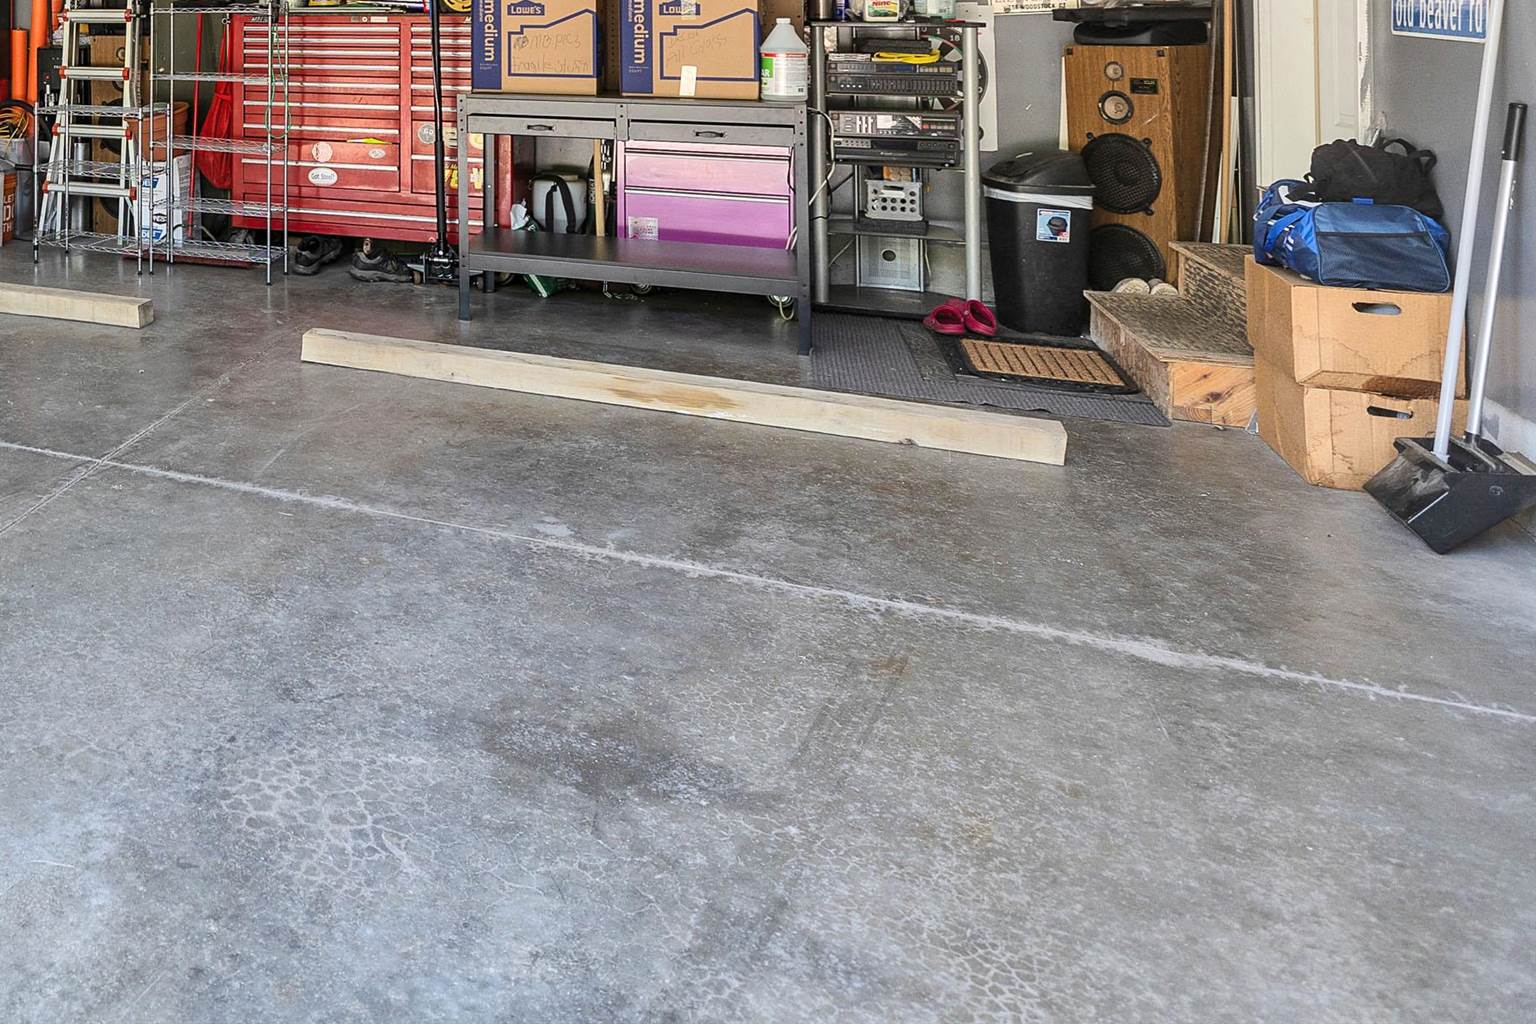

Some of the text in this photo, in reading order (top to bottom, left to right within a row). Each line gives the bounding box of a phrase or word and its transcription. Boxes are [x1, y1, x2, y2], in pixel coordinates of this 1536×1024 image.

[484, 0, 499, 62] medium
[511, 5, 542, 15] LOWE'S
[634, 0, 650, 64] medium
